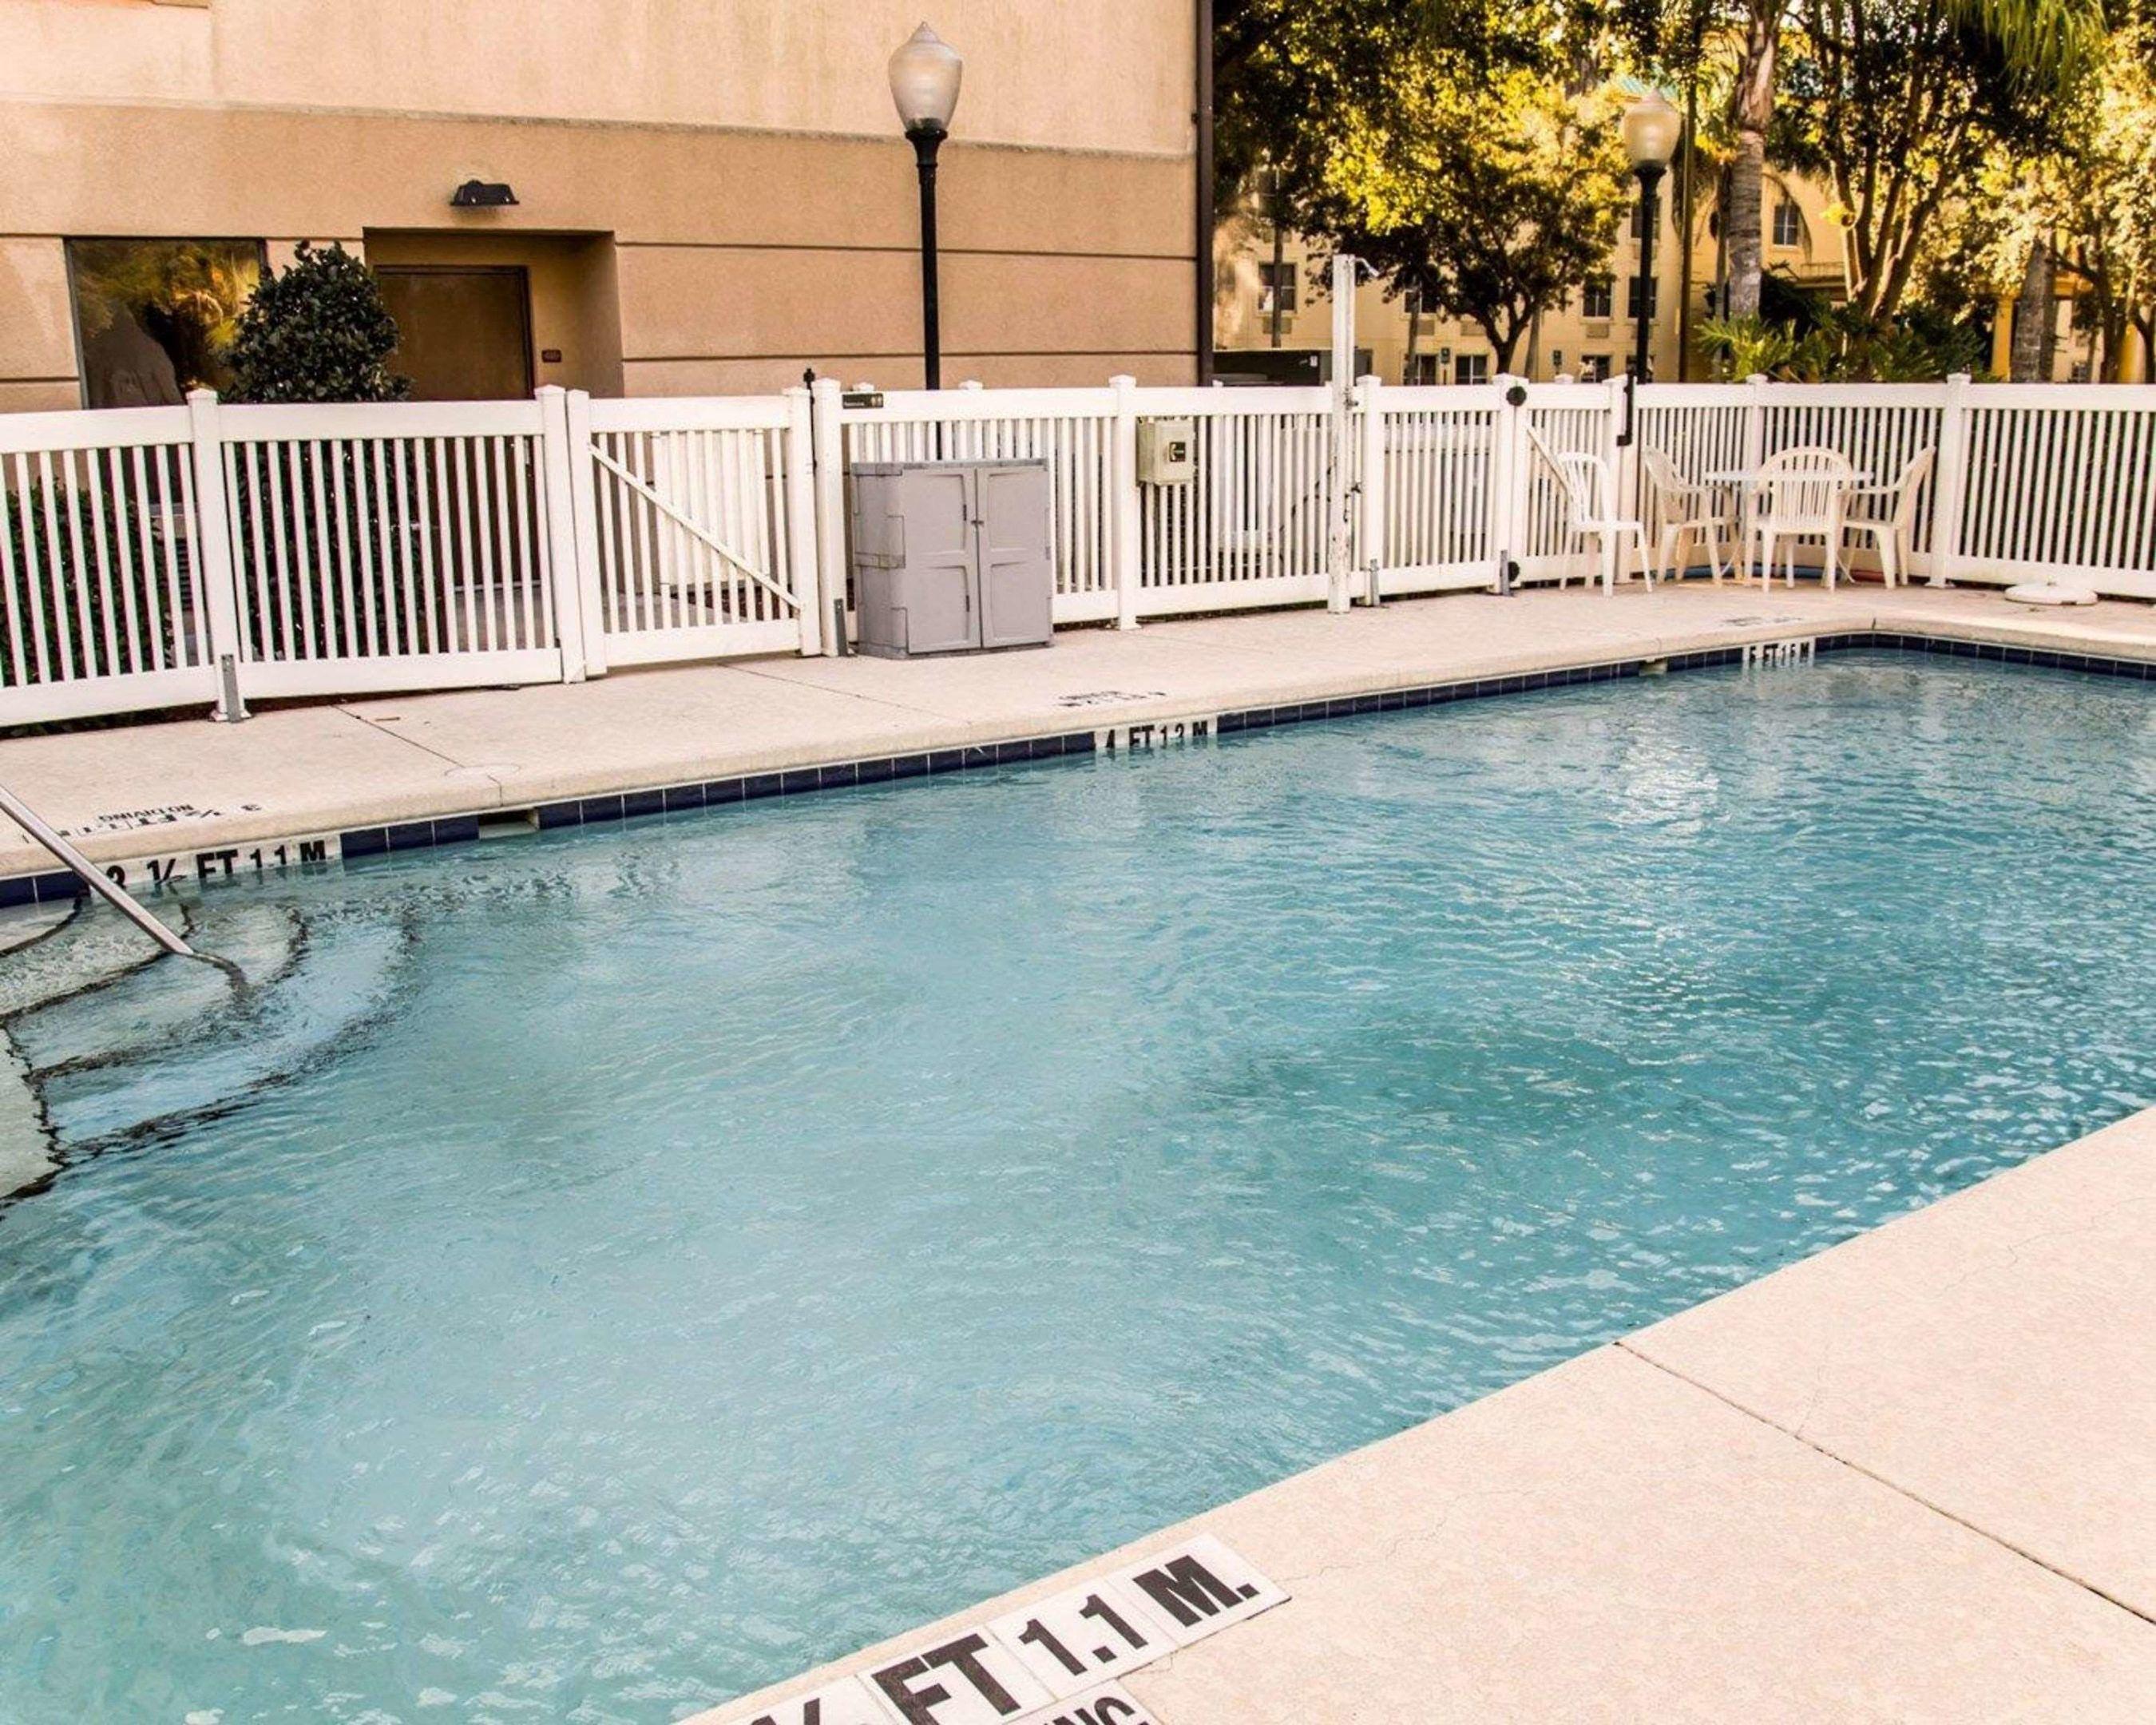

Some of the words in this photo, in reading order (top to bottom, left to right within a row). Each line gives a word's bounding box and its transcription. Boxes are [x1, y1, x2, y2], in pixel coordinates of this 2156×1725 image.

[1128, 724, 1155, 747] FT
[196, 849, 238, 878] FT
[871, 1633, 1021, 1725] FT
[1018, 1593, 1148, 1676] 1.1
[1132, 1554, 1261, 1628] M.
